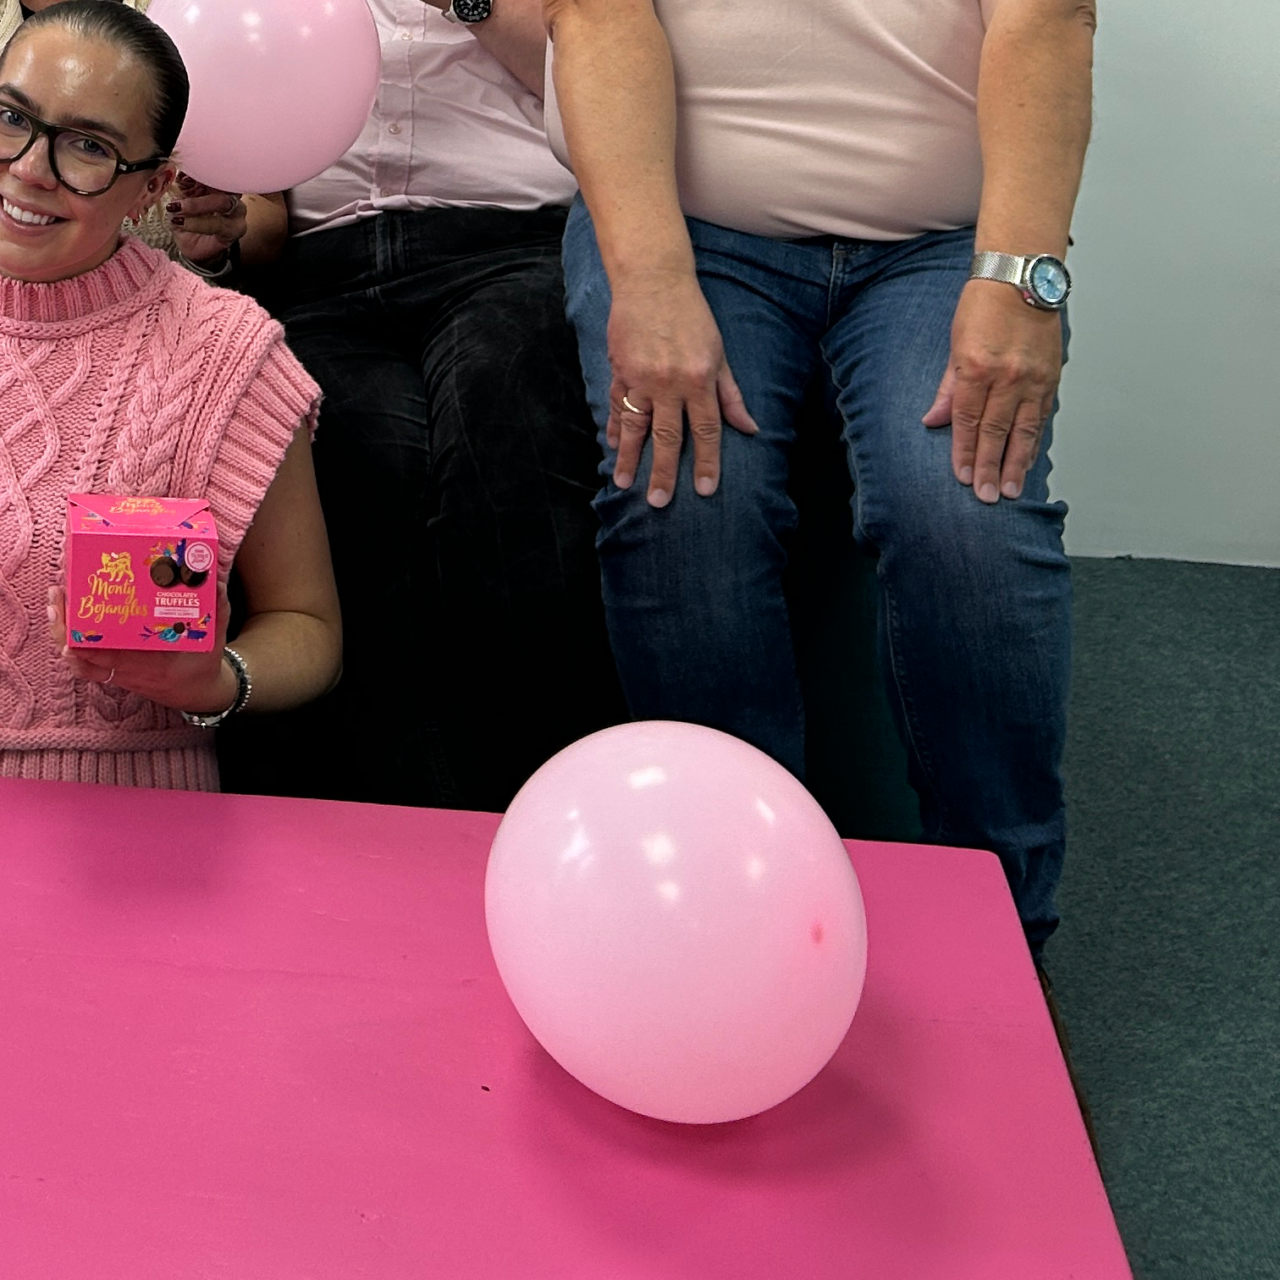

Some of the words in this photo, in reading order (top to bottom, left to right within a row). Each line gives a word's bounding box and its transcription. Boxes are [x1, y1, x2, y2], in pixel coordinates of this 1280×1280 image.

[88, 573, 136, 605] Monty
[154, 597, 200, 607] TRUFFLES
[77, 595, 148, 624] Bojangles
